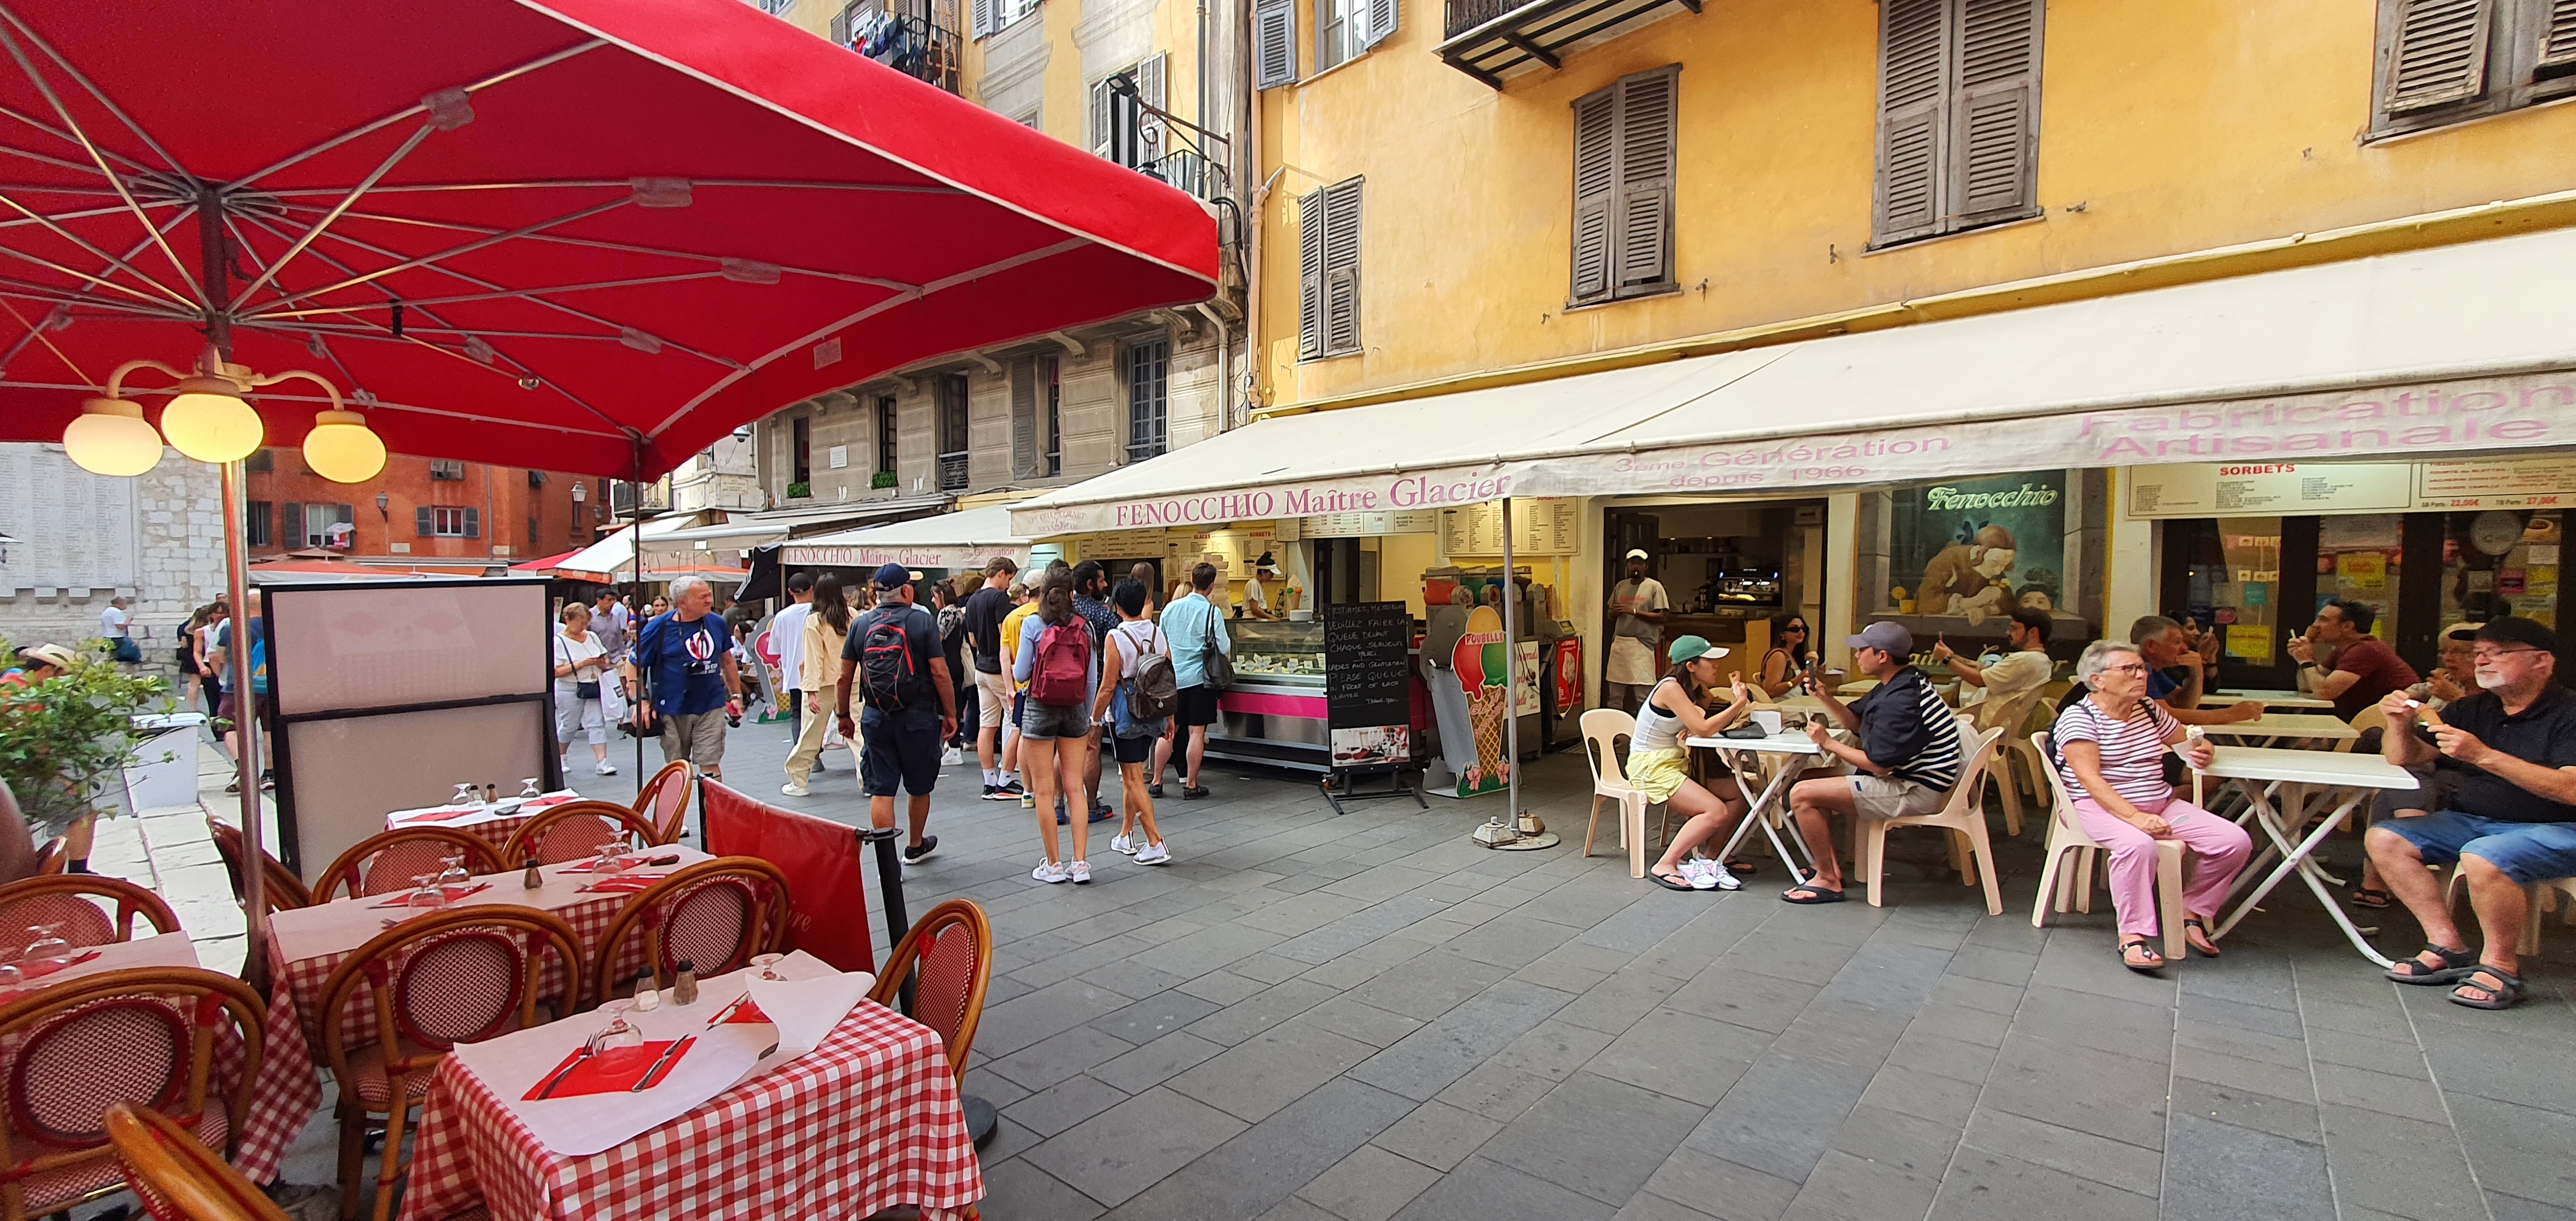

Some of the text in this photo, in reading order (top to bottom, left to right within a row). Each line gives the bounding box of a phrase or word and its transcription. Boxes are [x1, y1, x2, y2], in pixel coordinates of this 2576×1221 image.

[2081, 386, 2575, 435] Fabrication
[2097, 419, 2549, 460] Artisanale
[1613, 437, 1949, 472] 3ème Génération
[2220, 464, 2295, 476] SORBETS
[1670, 466, 1865, 487] depuis 1966
[1116, 491, 1273, 527] FENOCCHIO
[1284, 489, 1377, 514] Maître
[1390, 472, 1511, 507] Glacier
[1928, 483, 2058, 510] Fenocchio
[1059, 510, 1086, 519] CORNET
[787, 548, 942, 565] FENOCCHIO Maître Glacier
[974, 547, 1015, 557] Génération
[1328, 632, 1359, 643] QUEUE
[1466, 632, 1504, 643] POUBELLE
[1330, 643, 1362, 652] CHAQUE
[1367, 670, 1405, 682] QUEUE
[1342, 683, 1363, 692] FRONT
